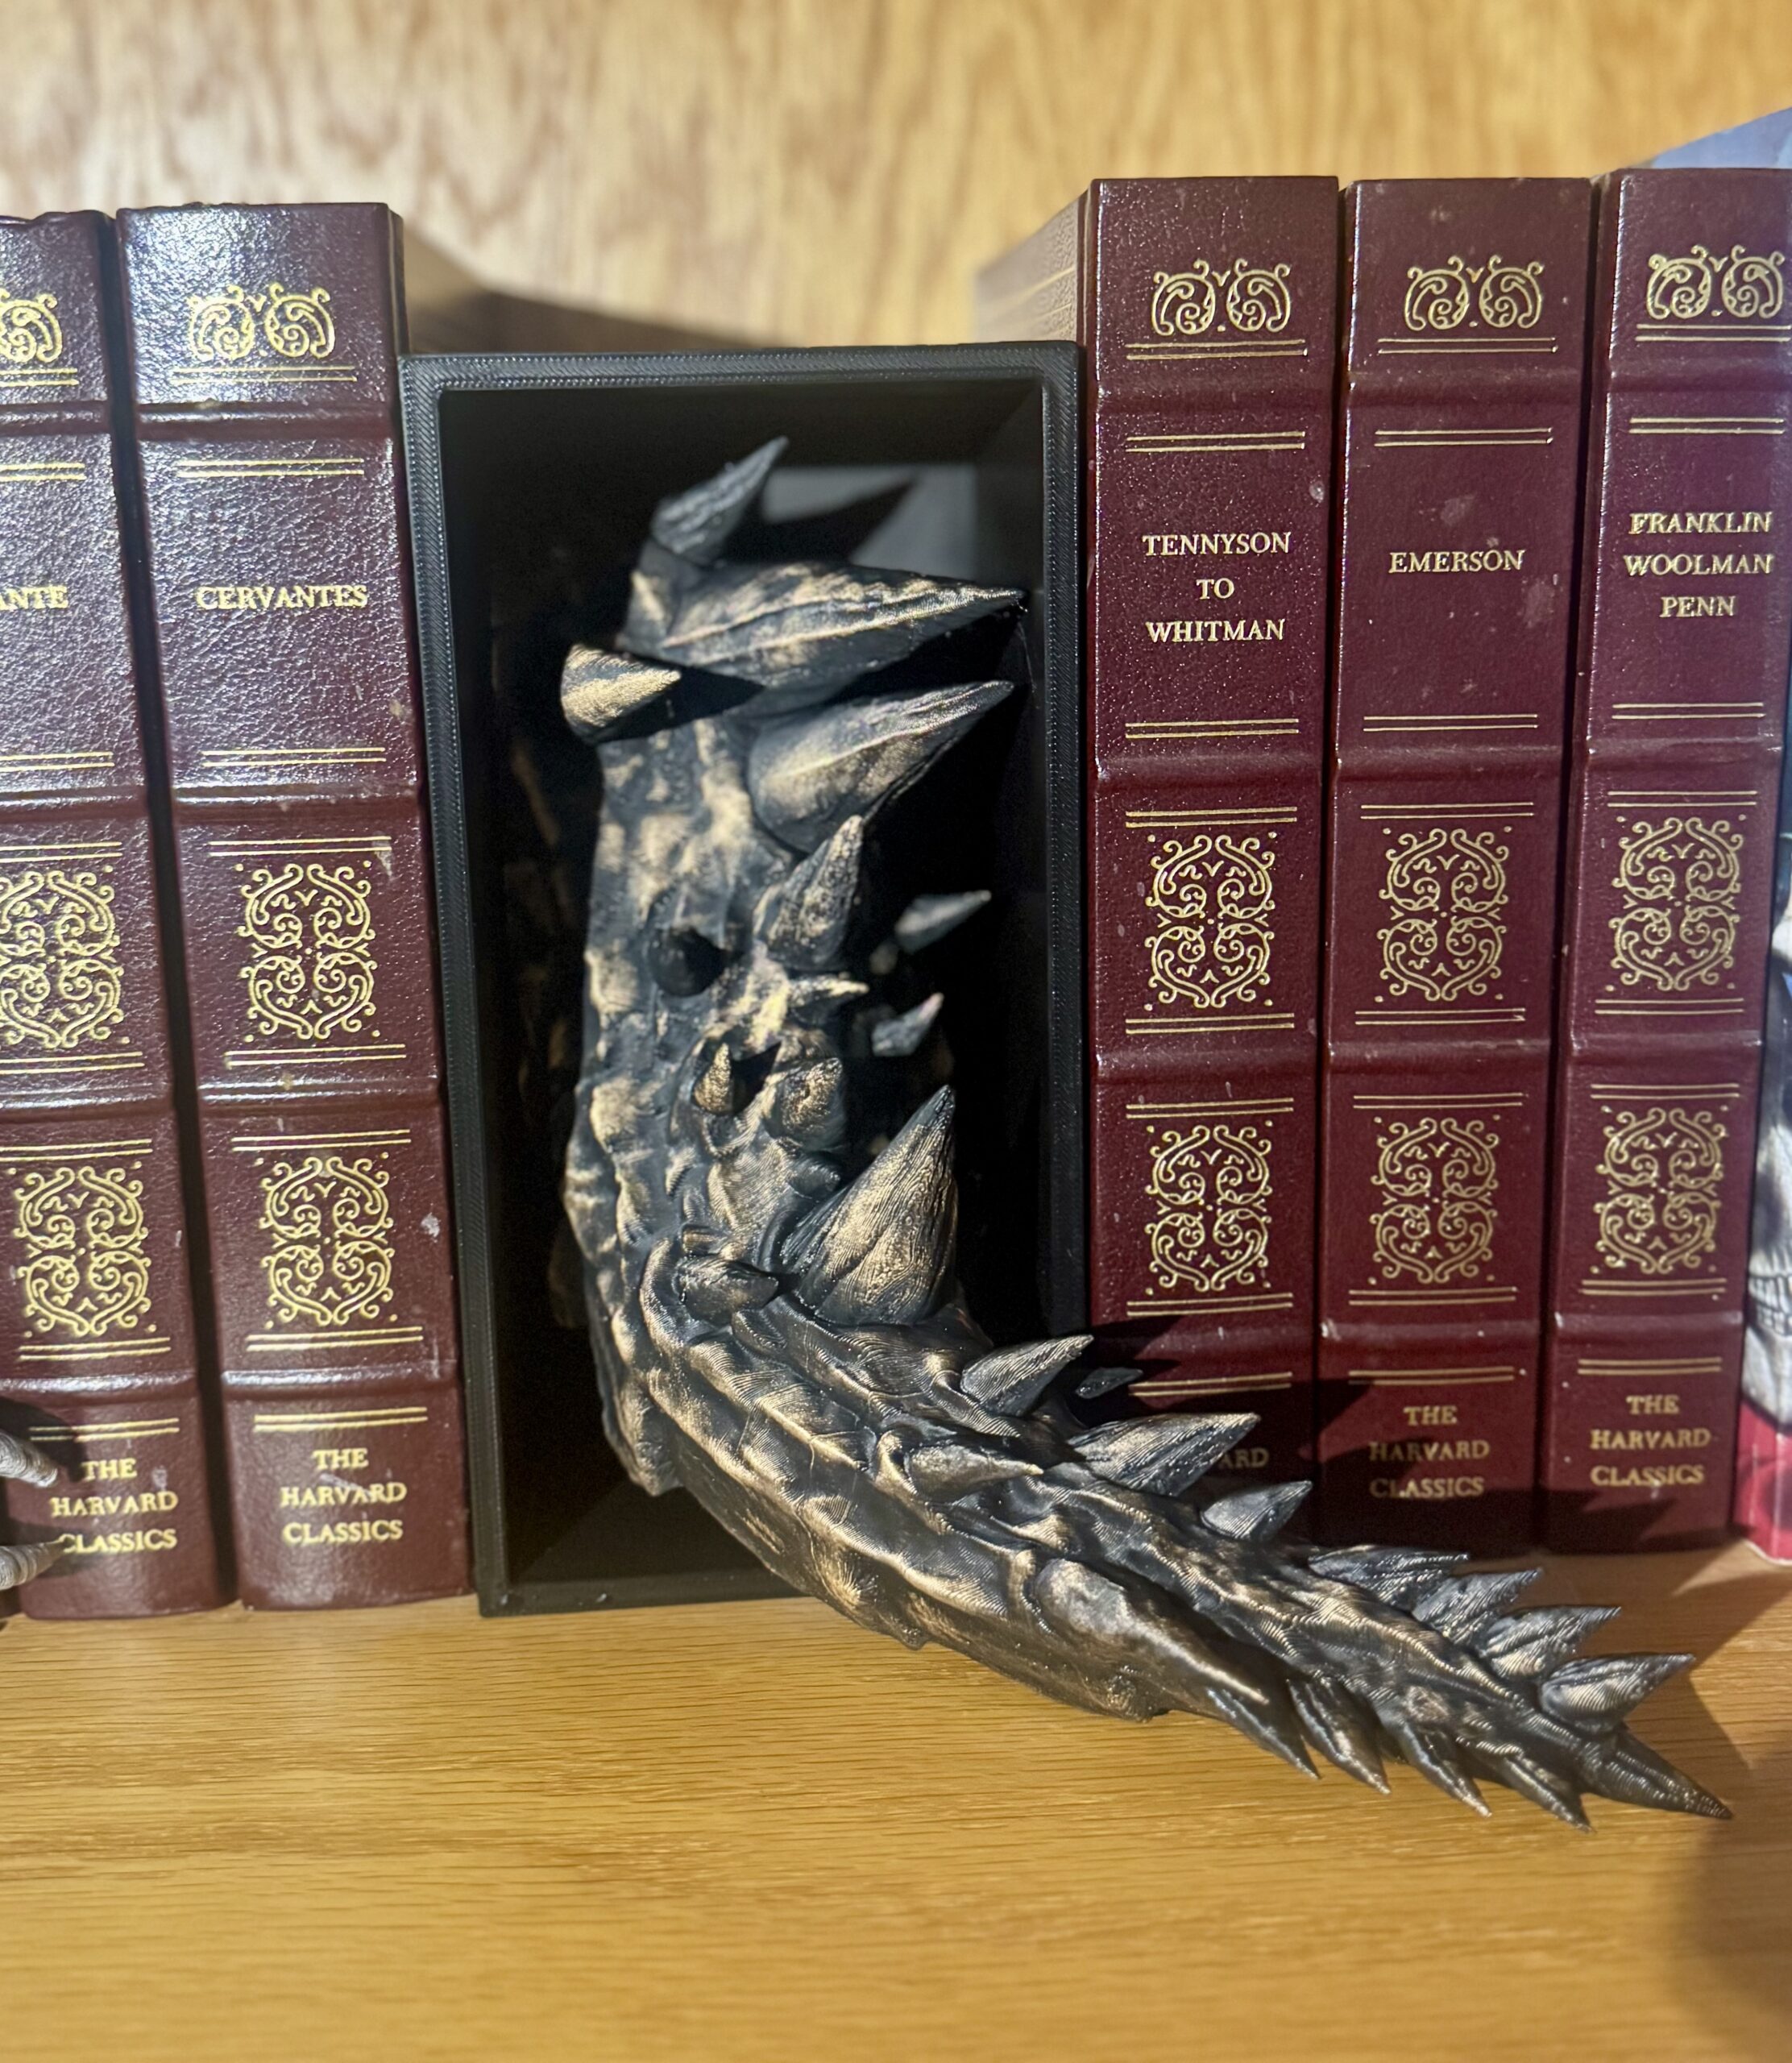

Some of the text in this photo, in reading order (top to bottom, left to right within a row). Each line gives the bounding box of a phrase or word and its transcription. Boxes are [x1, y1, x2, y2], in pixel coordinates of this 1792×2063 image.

[1628, 512, 1772, 534] FRANKLIN
[1143, 532, 1291, 556] TENNYSON
[1389, 550, 1524, 574] EMERSON
[1623, 554, 1773, 575] WOOLMAN
[194, 584, 368, 610] CERVANTES
[1197, 578, 1234, 600] TO
[1660, 596, 1736, 617] PENN
[1145, 619, 1285, 642] WHITMAN
[1404, 1405, 1458, 1426] THE
[1626, 1394, 1680, 1414] THE
[1590, 1427, 1711, 1450] HARVARD
[313, 1447, 368, 1470] THE
[1370, 1440, 1489, 1463] HARVARD
[81, 1458, 137, 1481] THE
[1590, 1464, 1705, 1487] CLASSICS
[280, 1482, 407, 1508] HARVARD
[1371, 1476, 1484, 1500] CLASSICS
[50, 1491, 179, 1518] HARVARD
[283, 1520, 403, 1545] CLASSICS
